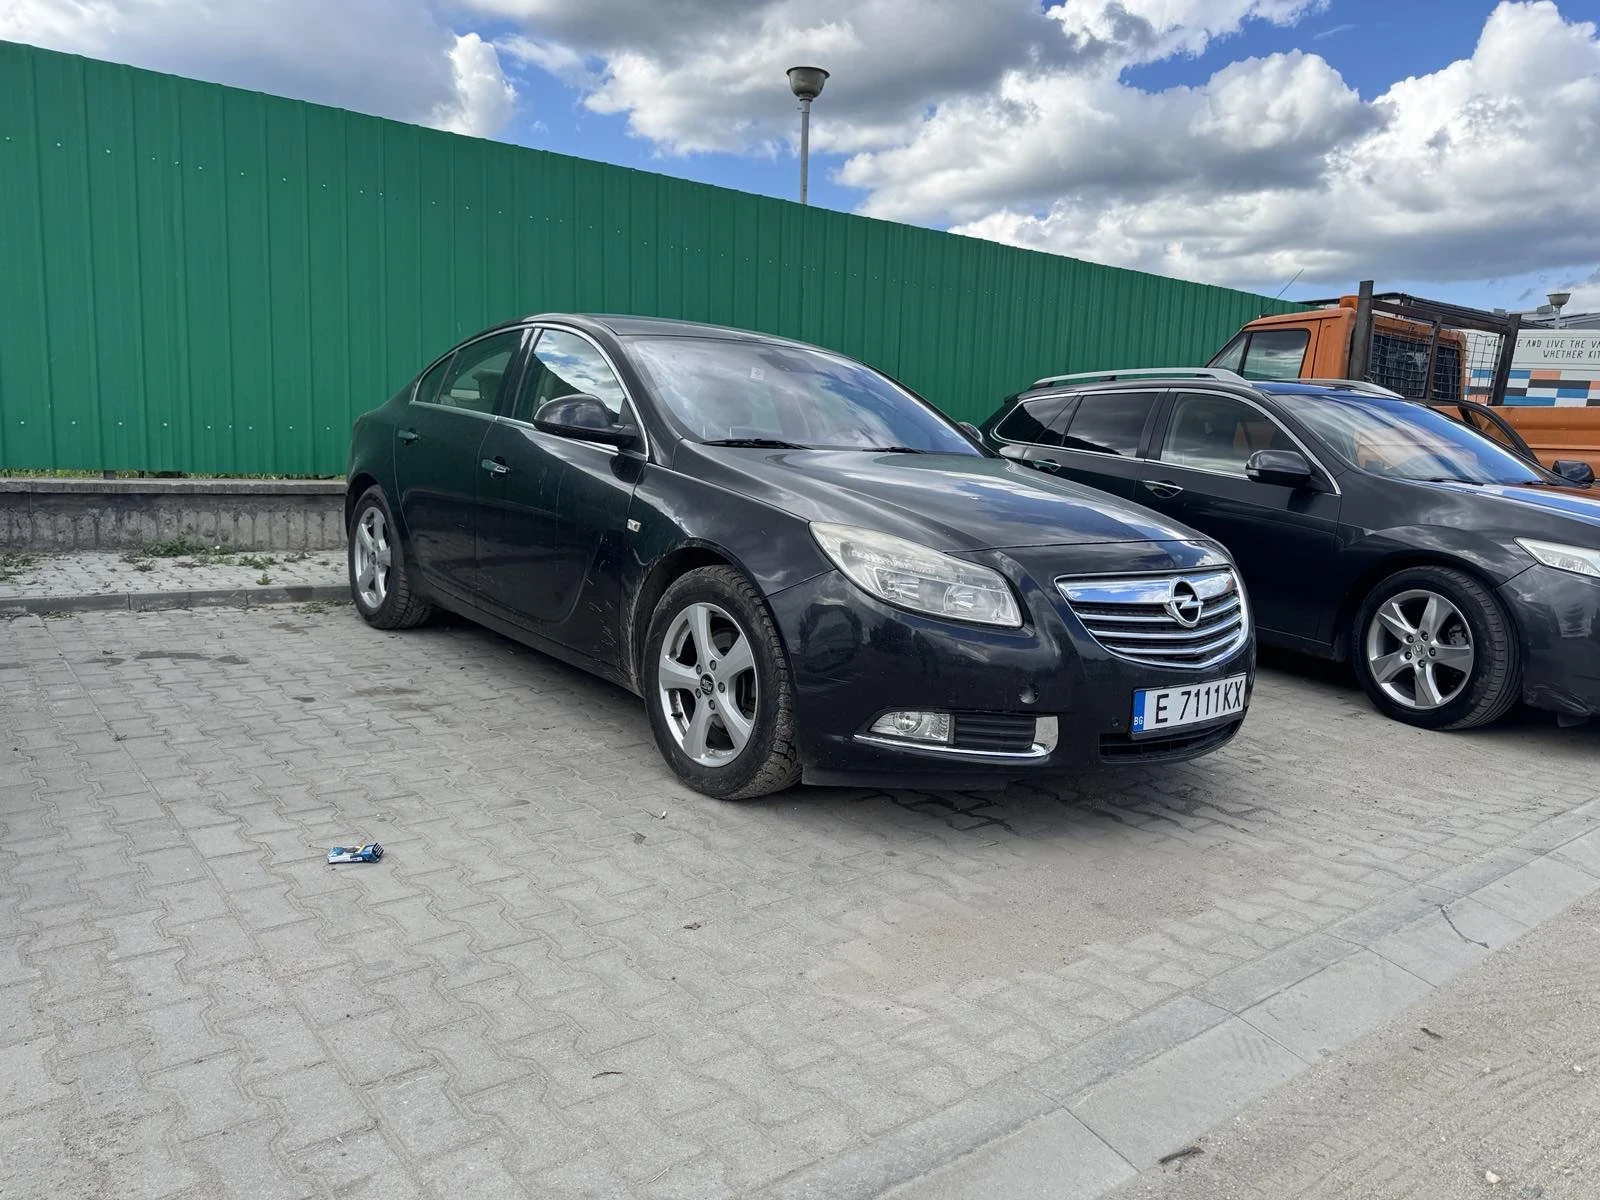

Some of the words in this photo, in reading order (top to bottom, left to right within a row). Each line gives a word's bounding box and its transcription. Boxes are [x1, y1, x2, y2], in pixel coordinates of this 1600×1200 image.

[1526, 339, 1542, 348] AND
[1546, 339, 1565, 348] LIVE
[1570, 339, 1586, 349] THE
[1543, 349, 1583, 359] WHETHER
[1155, 693, 1170, 724] E
[1179, 680, 1243, 720] 7111KX
[1133, 716, 1143, 725] BG
